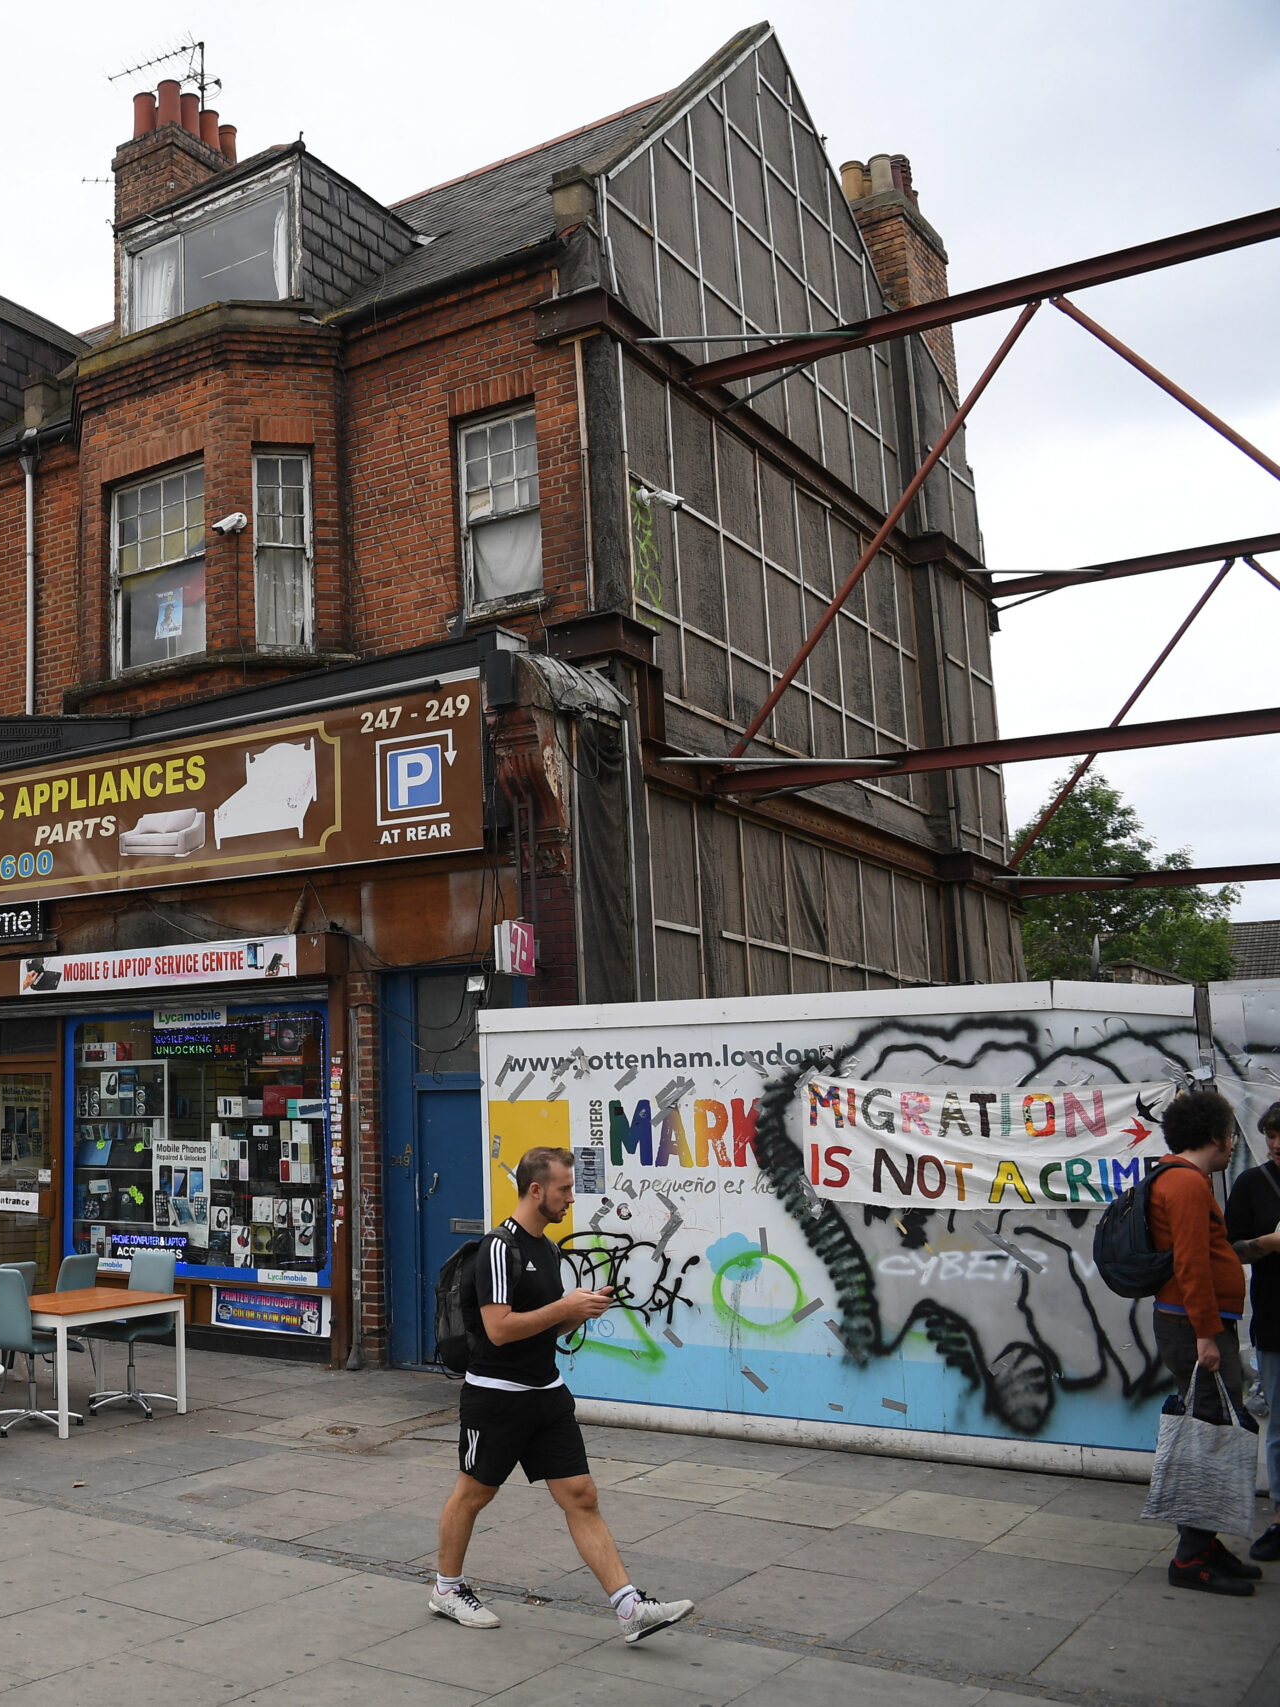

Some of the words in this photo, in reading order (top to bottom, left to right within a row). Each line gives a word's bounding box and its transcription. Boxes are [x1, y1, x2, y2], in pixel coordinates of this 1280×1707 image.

[360, 705, 402, 734] 247
[425, 693, 471, 723] 249
[14, 755, 206, 820] APPLIANCES
[35, 815, 117, 847] PARTS
[379, 827, 403, 845] AT
[406, 822, 452, 843] REAR
[63, 961, 100, 982] MOBILE
[102, 961, 110, 979] &
[112, 956, 151, 978] LAPTOP
[154, 952, 199, 974] SERVICE
[202, 949, 244, 972] CENTRE
[158, 1008, 221, 1026] Lycamobile
[156, 1044, 213, 1055] UNLOCKING
[215, 1044, 222, 1054] &
[509, 1043, 819, 1072] www.ottenham.london
[808, 1082, 1108, 1139] MIGRATION
[609, 1096, 762, 1168] MARK
[156, 1143, 180, 1154] Mobile
[181, 1144, 207, 1154] Phones
[156, 1153, 179, 1162] Repaired
[183, 1154, 207, 1162] Unlocked
[257, 1143, 269, 1151] S10
[405, 1144, 413, 1155] A
[810, 1143, 853, 1188] IS
[872, 1147, 974, 1202] NOT
[988, 1160, 1036, 1204] A
[640, 1175, 717, 1199] pequeño
[724, 1179, 743, 1193] es
[112, 1234, 129, 1244] PHONE
[130, 1235, 160, 1246] COMPUTER
[159, 1236, 165, 1246] &
[165, 1236, 187, 1247] LAPTOP
[99, 1261, 124, 1269] amobile
[267, 1272, 308, 1283] Lycamobile
[220, 1291, 249, 1304] PRINTER
[256, 1295, 298, 1310] PHOTOCOPY
[300, 1301, 319, 1312] HERE
[232, 1308, 255, 1319] COLOR
[281, 1314, 303, 1326] PRINT
